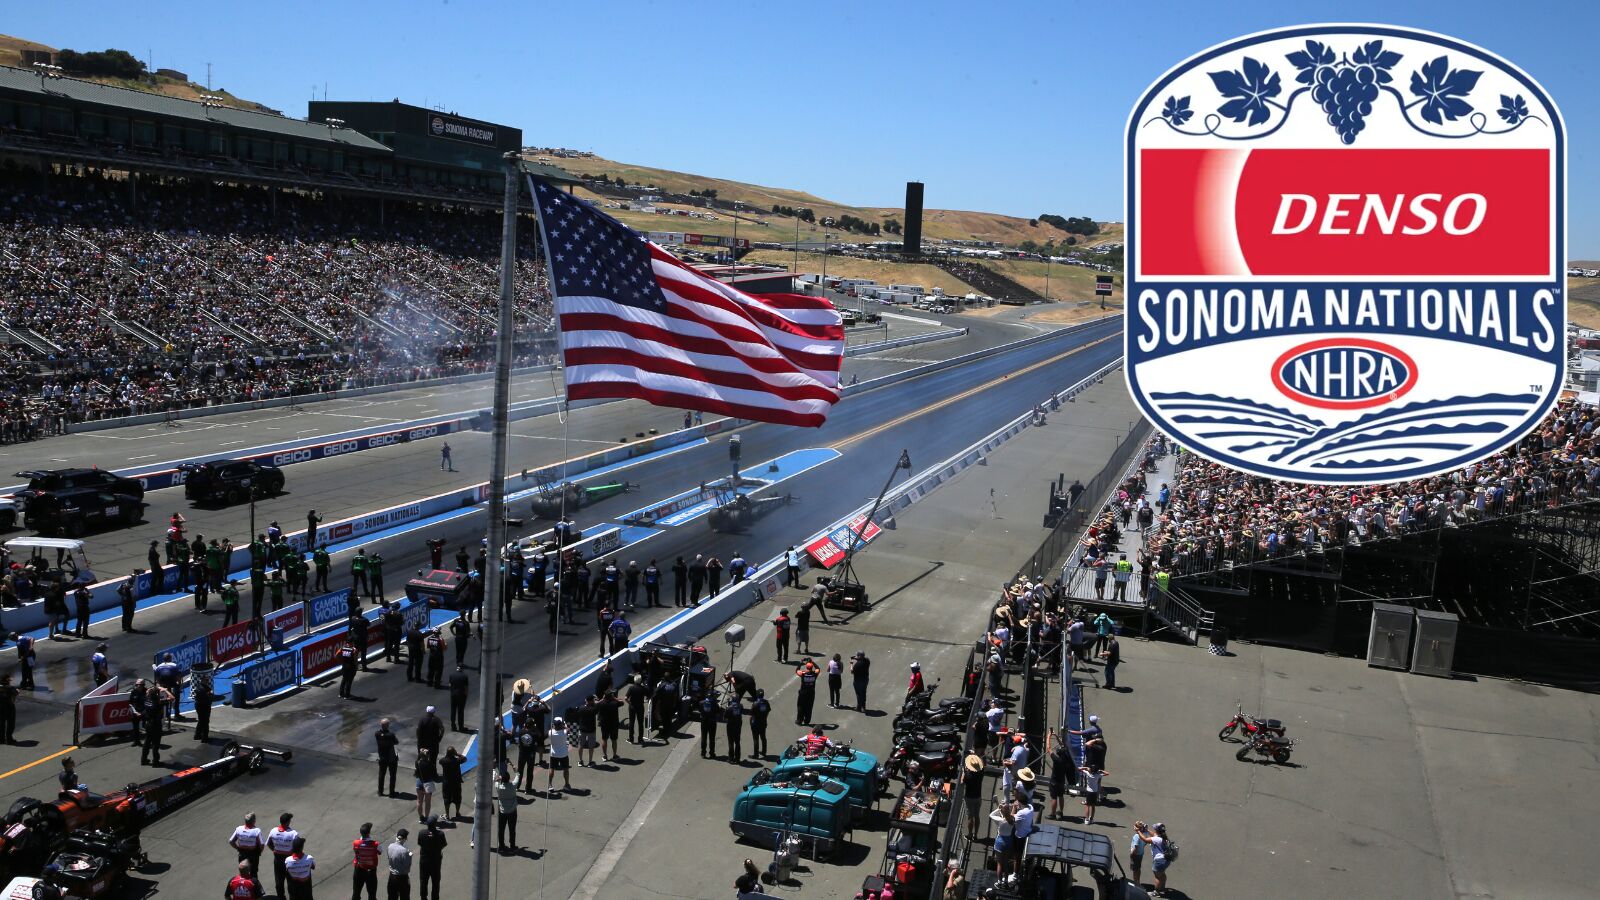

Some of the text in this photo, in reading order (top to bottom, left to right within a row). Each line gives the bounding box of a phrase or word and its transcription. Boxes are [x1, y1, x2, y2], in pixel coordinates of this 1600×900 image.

[445, 123, 494, 141] SONOMA RACEWAY
[274, 426, 438, 466] GEICO GEICO GEICO GEICO
[364, 513, 389, 529] SONOMA
[390, 506, 420, 524] NATIONALS
[314, 593, 348, 613] CAMPING
[315, 603, 349, 623] WORLD
[277, 615, 298, 628] DENSO
[172, 643, 202, 662] AMPING
[217, 633, 244, 655] LUCAS
[307, 645, 332, 669] LUCAS
[251, 656, 292, 681] CAMPING
[252, 668, 293, 694] WORLD
